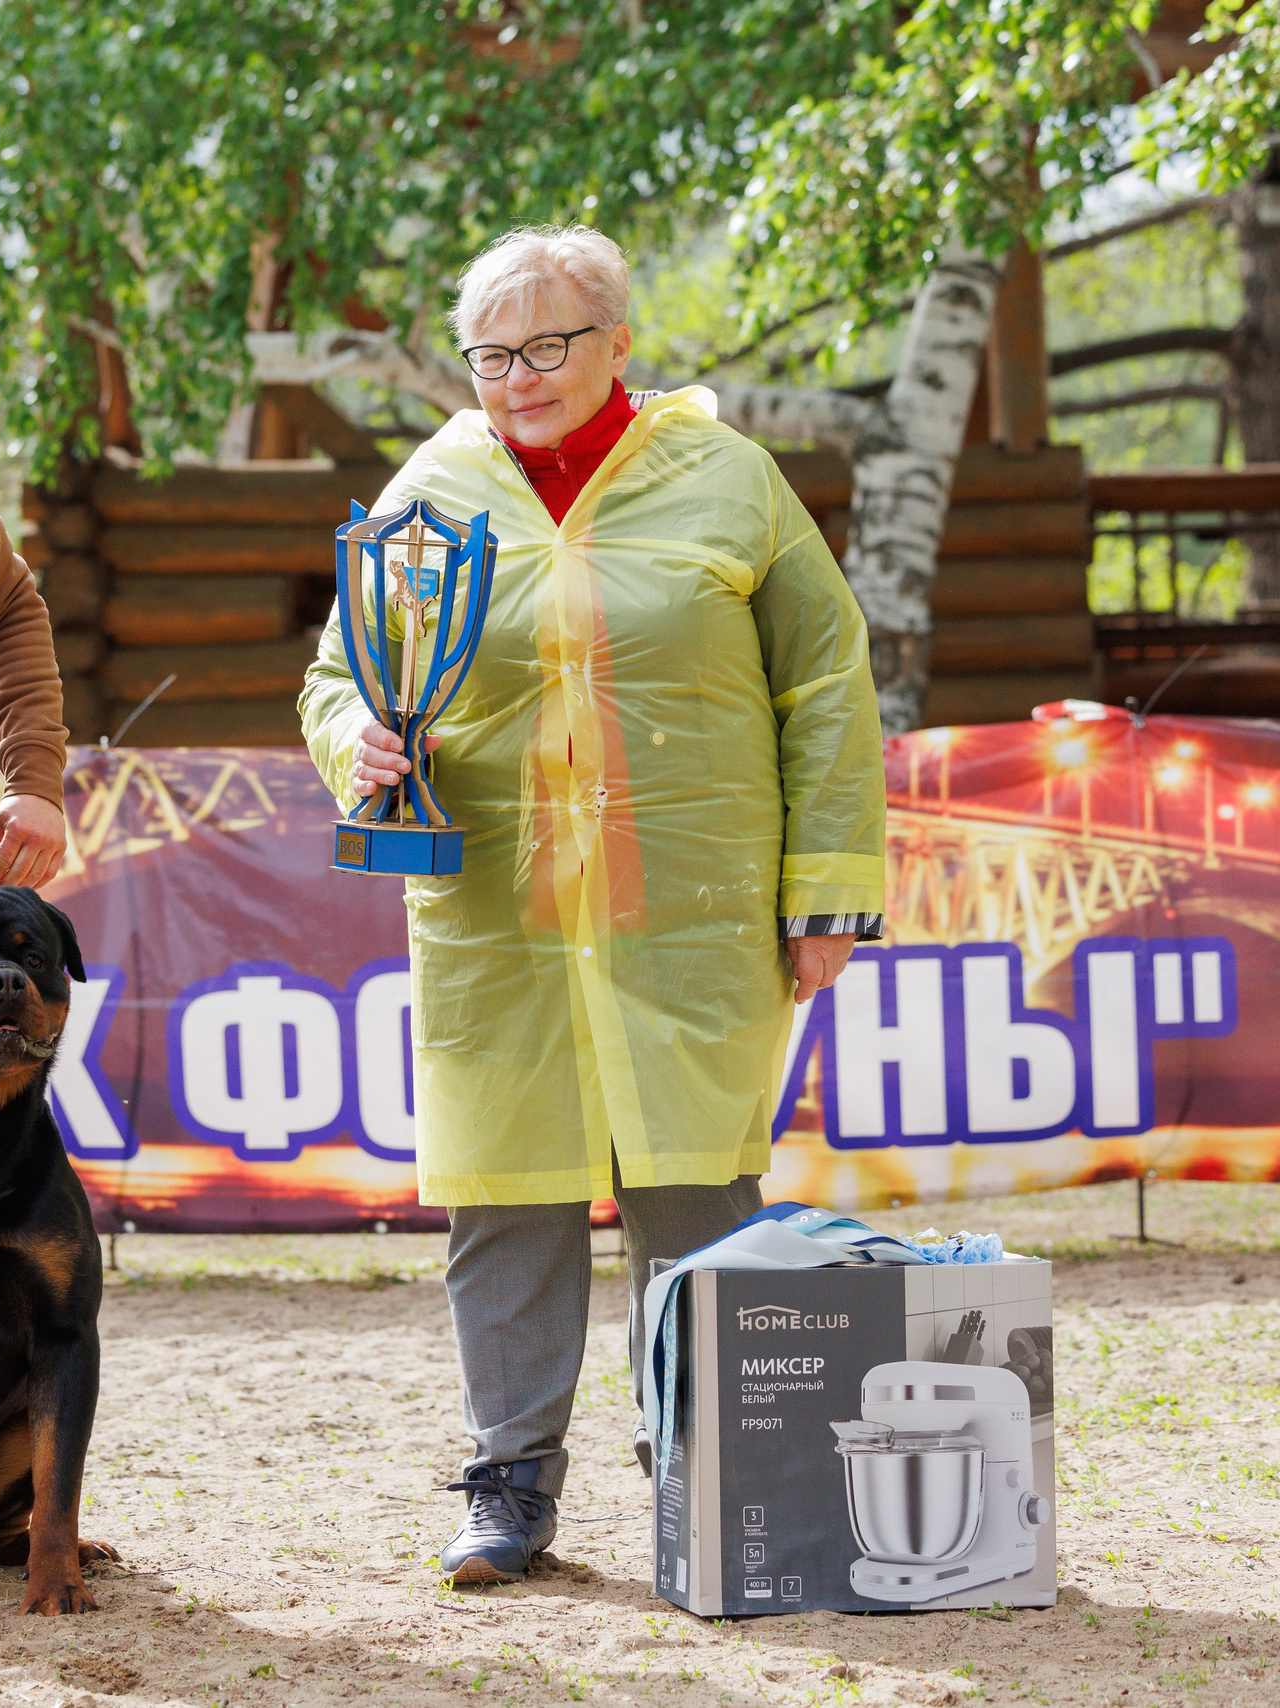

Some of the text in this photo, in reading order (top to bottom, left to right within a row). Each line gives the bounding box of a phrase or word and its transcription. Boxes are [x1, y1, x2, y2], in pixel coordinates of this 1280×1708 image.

[339, 839, 363, 857] BOS
[741, 1357, 825, 1376] МИКСЕР
[741, 1380, 824, 1392] СТАЦИОНАРНЫЙ
[742, 1393, 775, 1404] БЕЛЫЙ
[742, 1418, 783, 1430] FP9071
[750, 1511, 756, 1521] 3
[788, 1581, 794, 1590] 7
